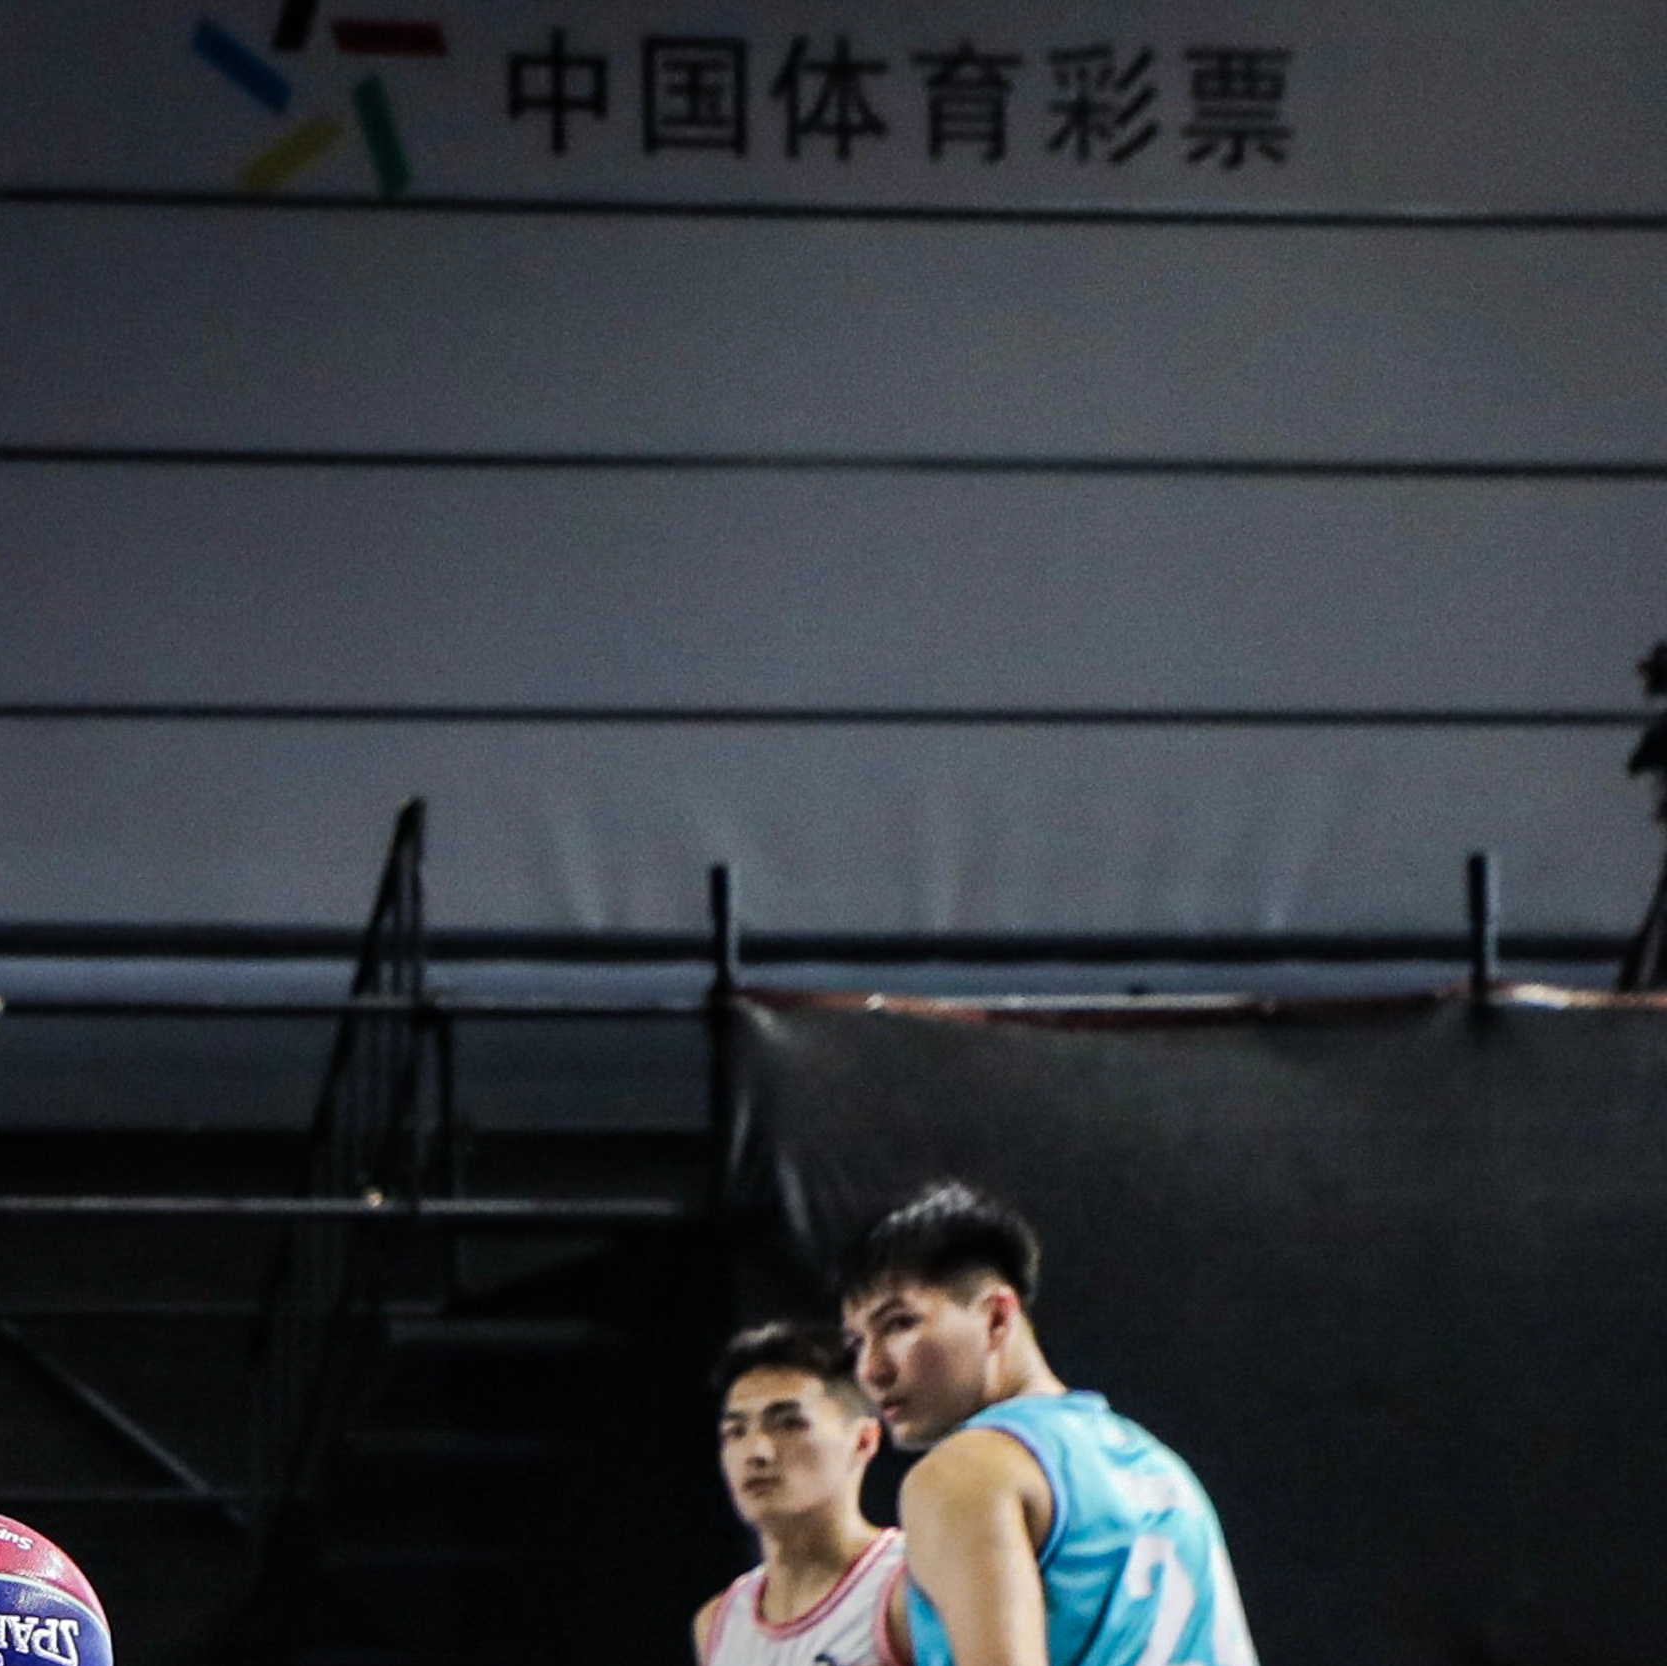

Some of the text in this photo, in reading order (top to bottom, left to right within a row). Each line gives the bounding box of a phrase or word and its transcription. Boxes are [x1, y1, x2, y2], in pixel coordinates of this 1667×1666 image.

[505, 26, 1292, 168] 中国体育彩票
